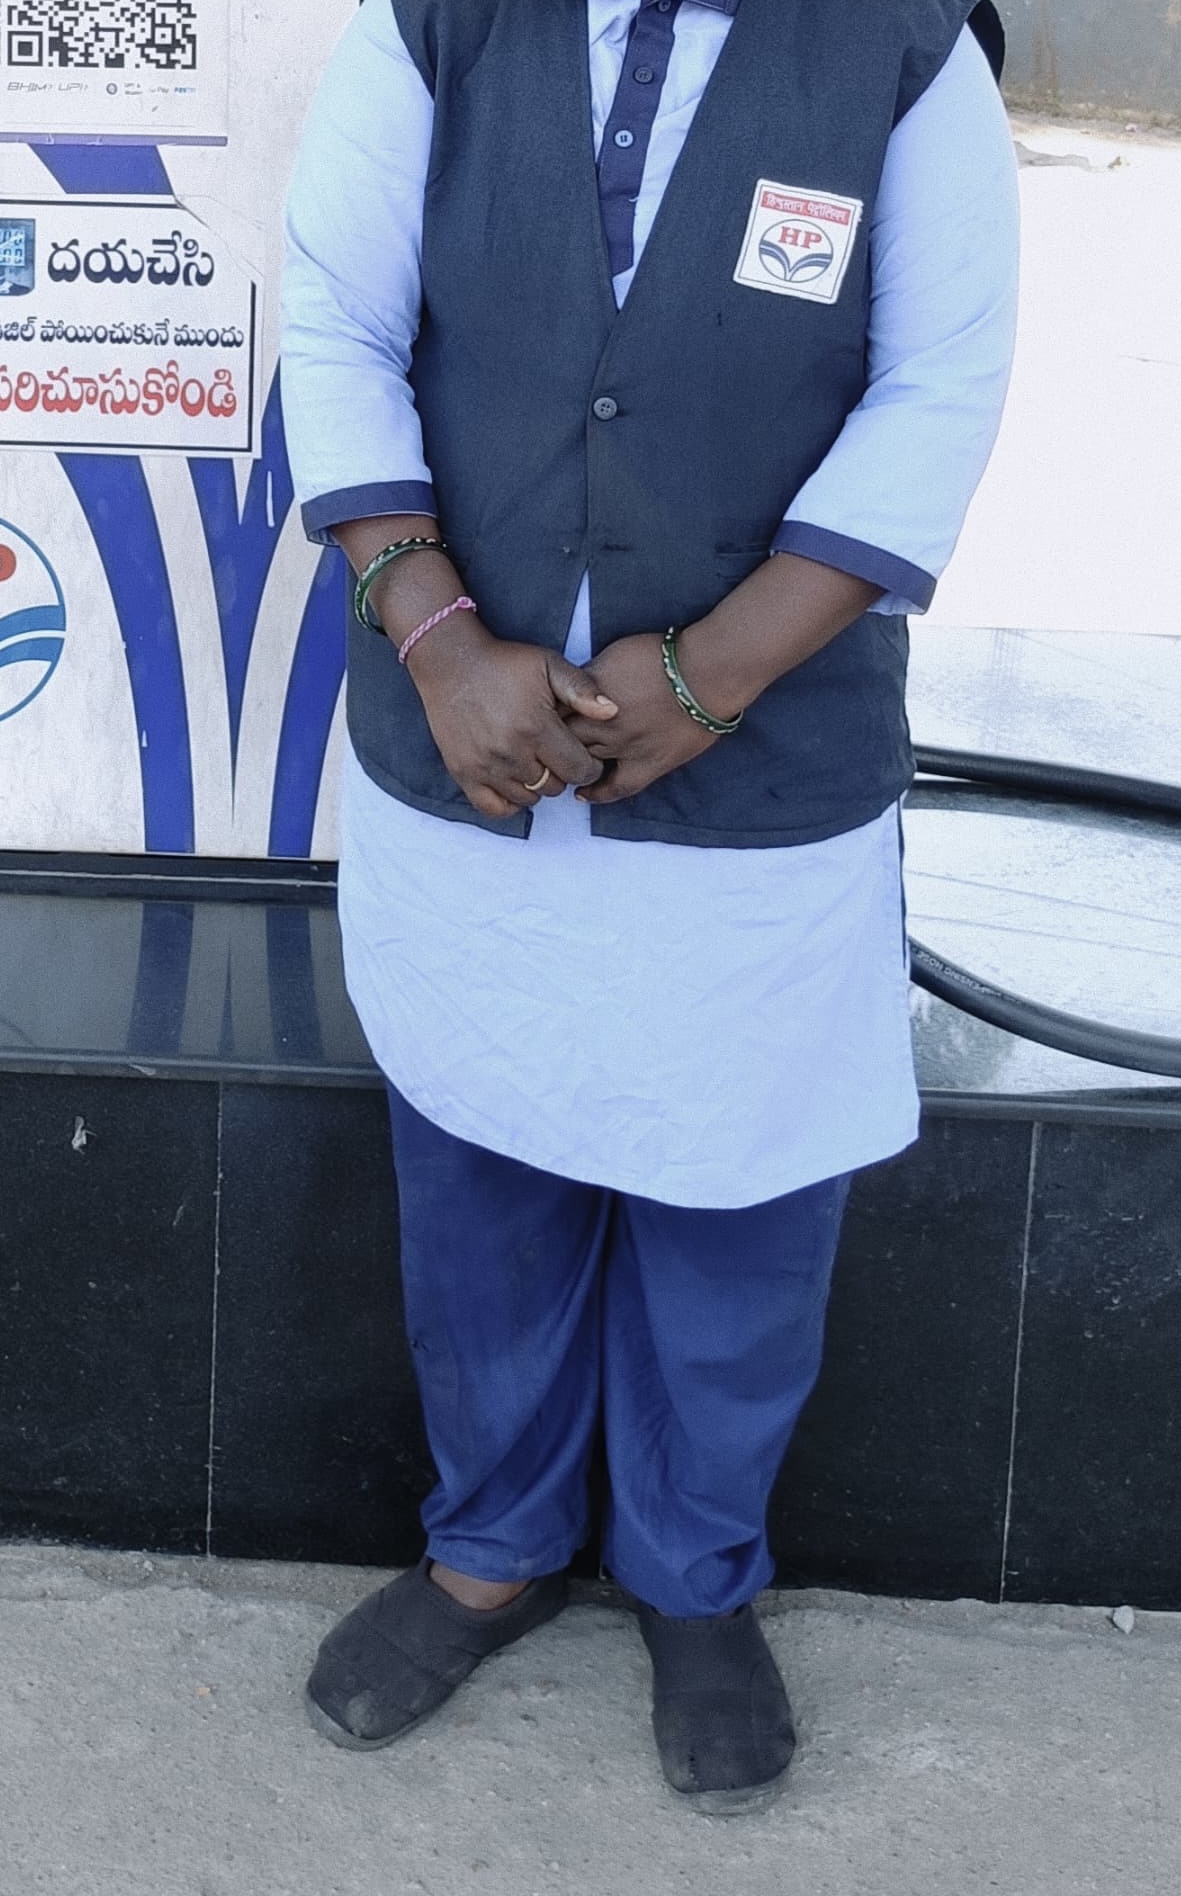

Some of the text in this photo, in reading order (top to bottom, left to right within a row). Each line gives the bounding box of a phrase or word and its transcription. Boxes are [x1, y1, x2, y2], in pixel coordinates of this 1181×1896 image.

[778, 226, 822, 249] HP
[47, 230, 215, 286] దయచేసి
[174, 326, 244, 348] ముందు
